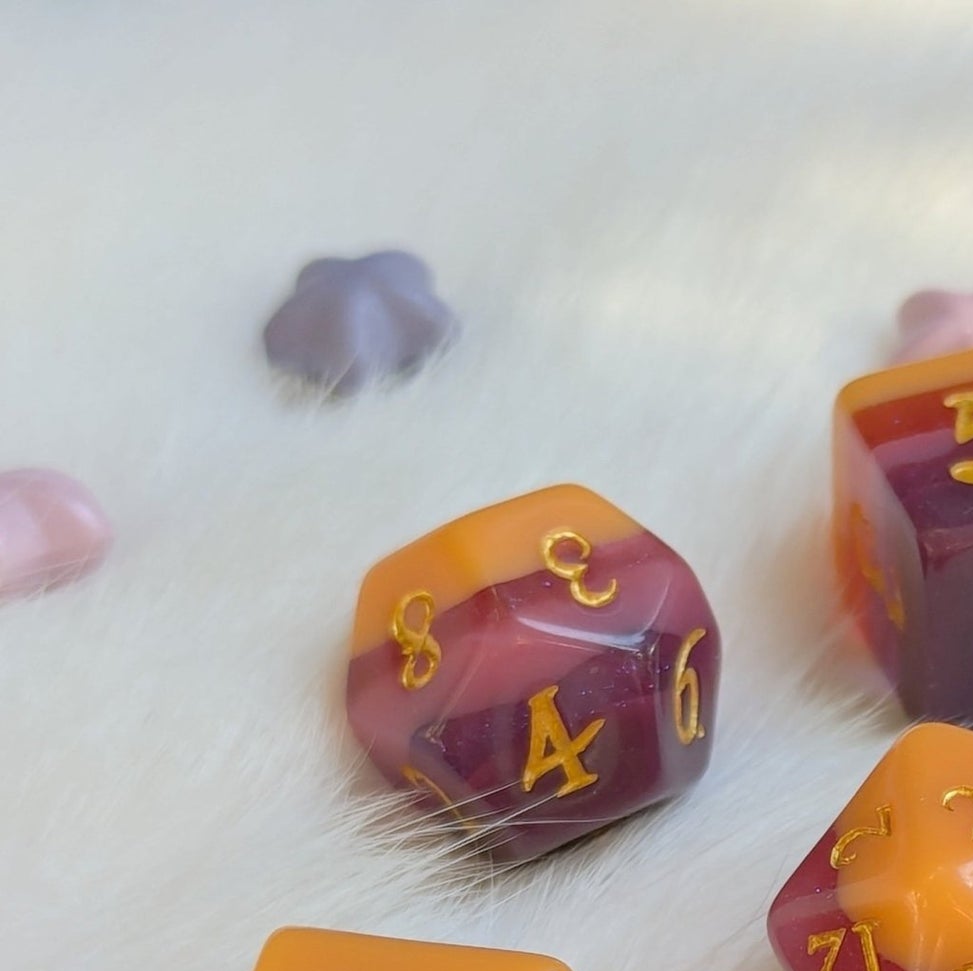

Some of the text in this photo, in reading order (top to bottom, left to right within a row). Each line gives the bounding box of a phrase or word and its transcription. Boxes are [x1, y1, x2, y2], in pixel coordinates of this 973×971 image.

[540, 527, 617, 608] 3
[391, 589, 442, 690] 8
[521, 685, 606, 797] 4
